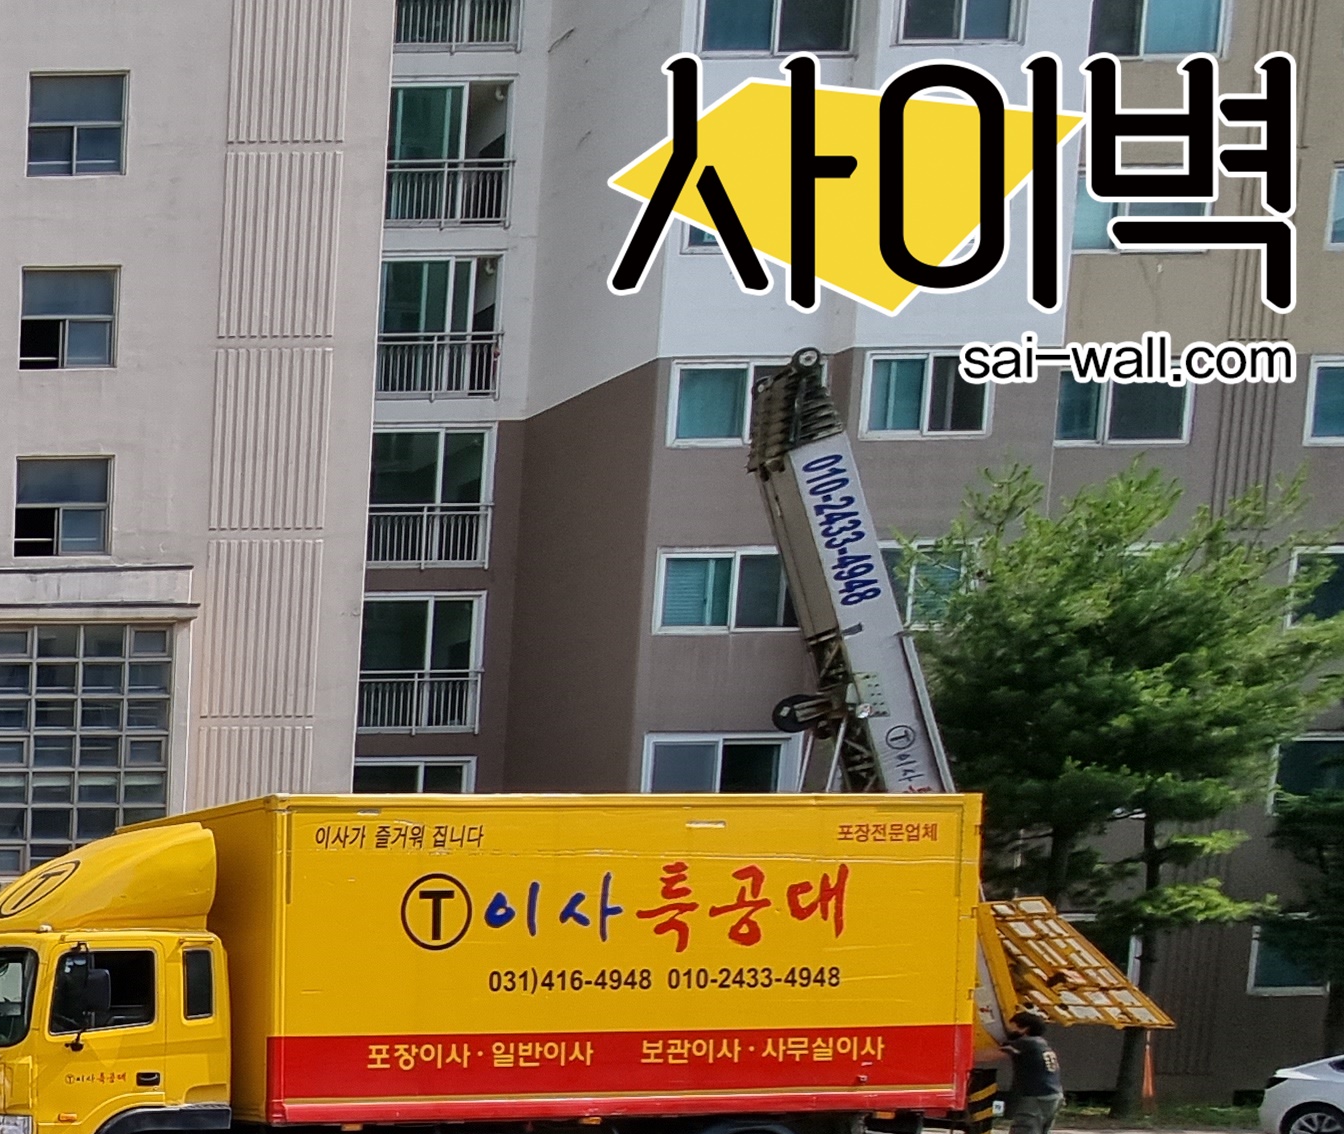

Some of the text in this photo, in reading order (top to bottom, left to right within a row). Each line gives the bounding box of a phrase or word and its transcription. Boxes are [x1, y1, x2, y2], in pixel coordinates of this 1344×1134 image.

[802, 454, 881, 606] 010-2433-4948
[315, 825, 484, 849] 이사가 즐거워 집니다
[836, 823, 938, 843] 포장전문업체
[488, 966, 841, 994] 031)416-4948 010-2433-4948
